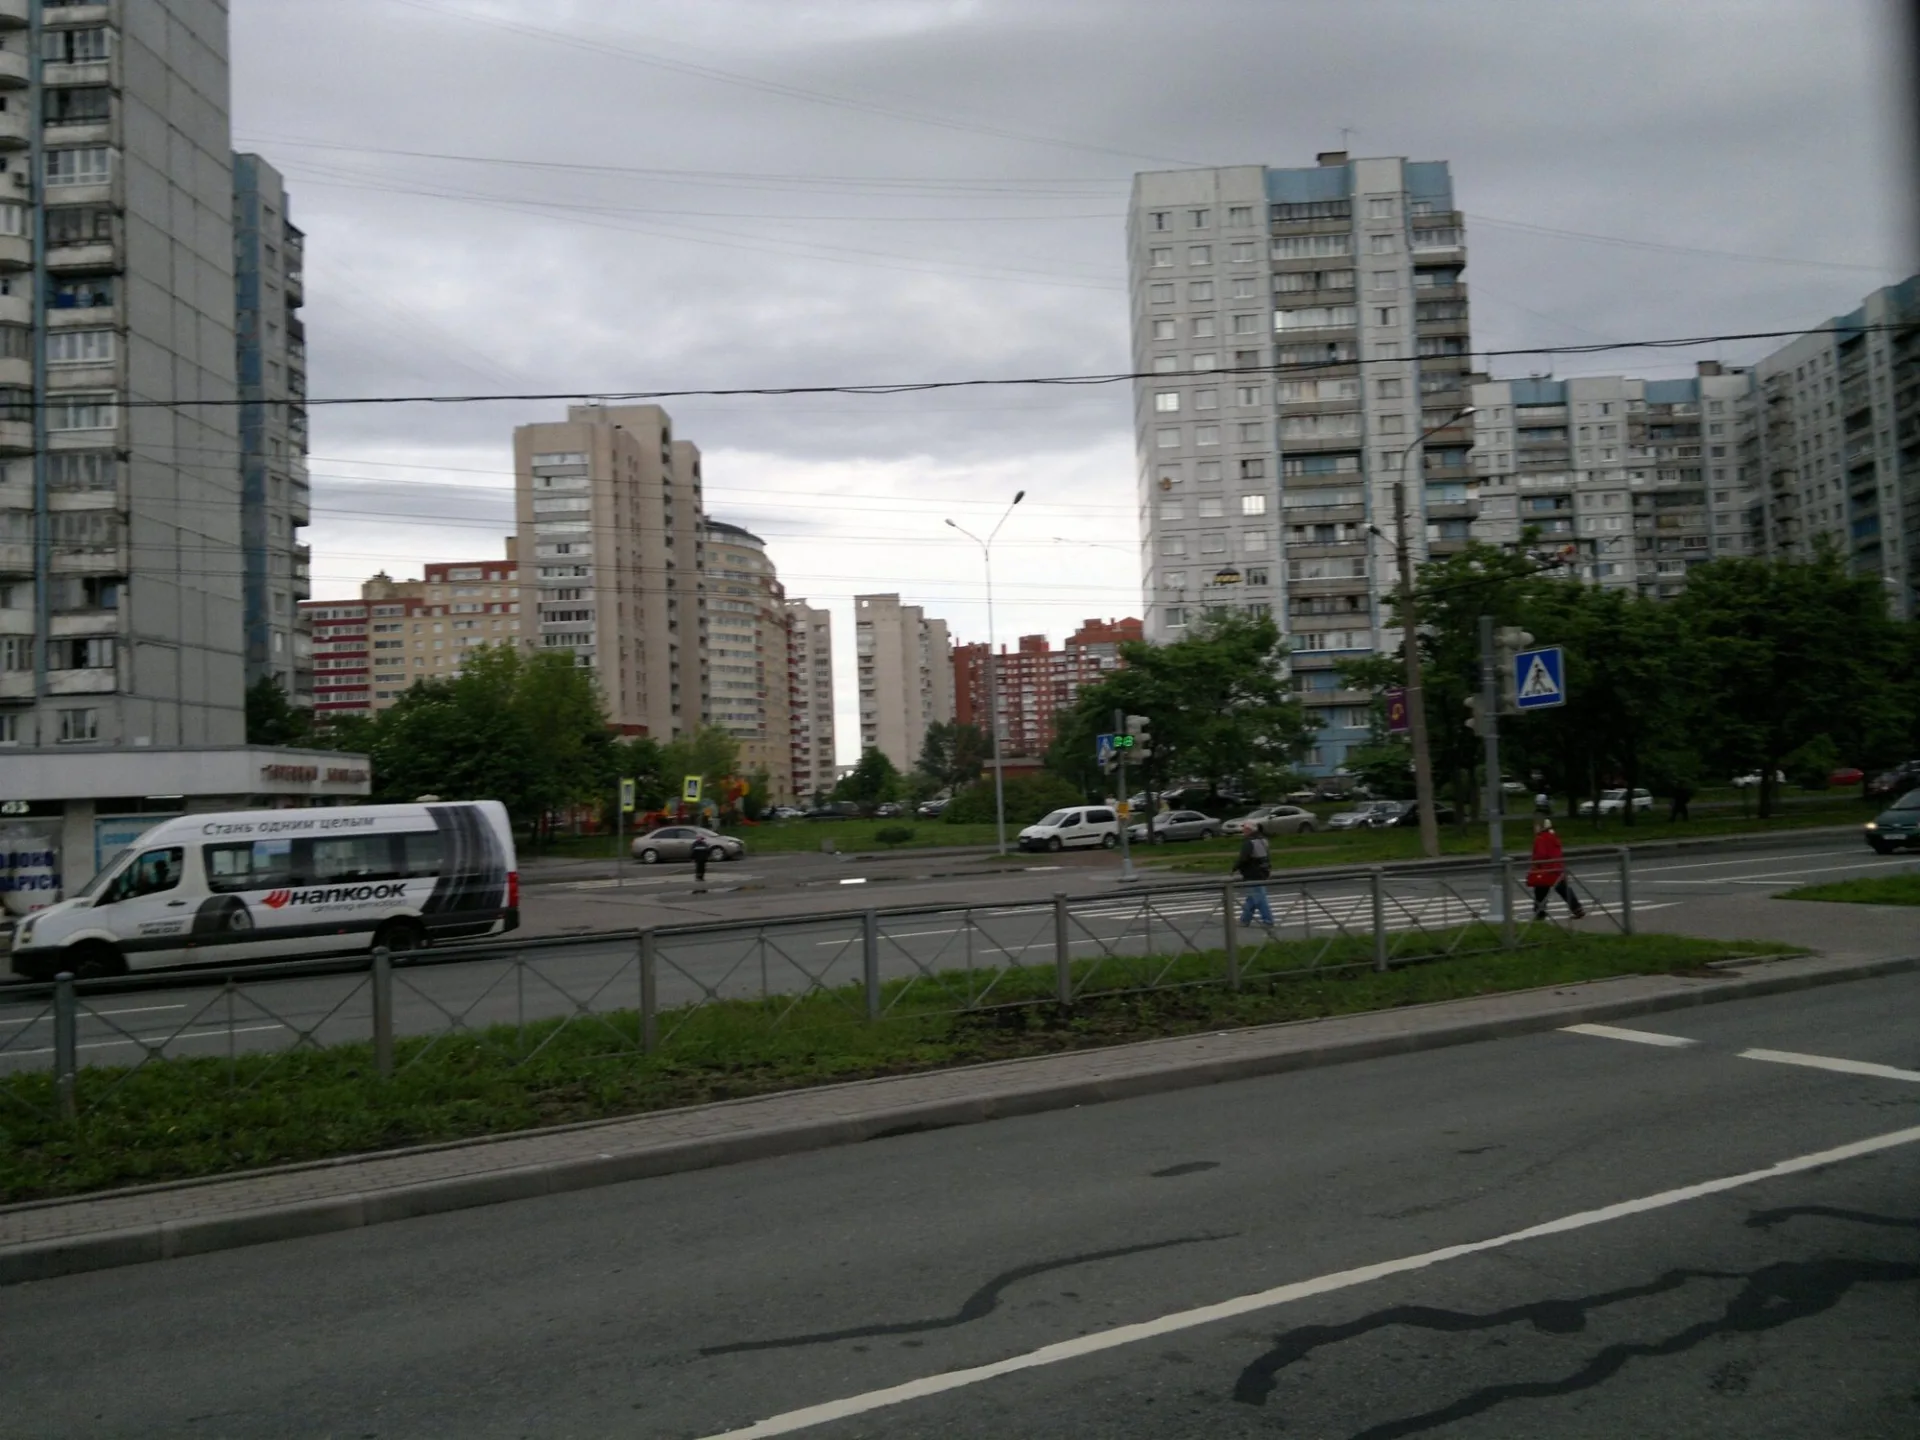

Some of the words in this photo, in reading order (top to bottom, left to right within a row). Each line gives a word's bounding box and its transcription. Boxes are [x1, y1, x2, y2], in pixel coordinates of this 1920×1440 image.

[202, 822, 253, 836] Стань
[258, 820, 315, 834] одним
[320, 816, 376, 830] целым
